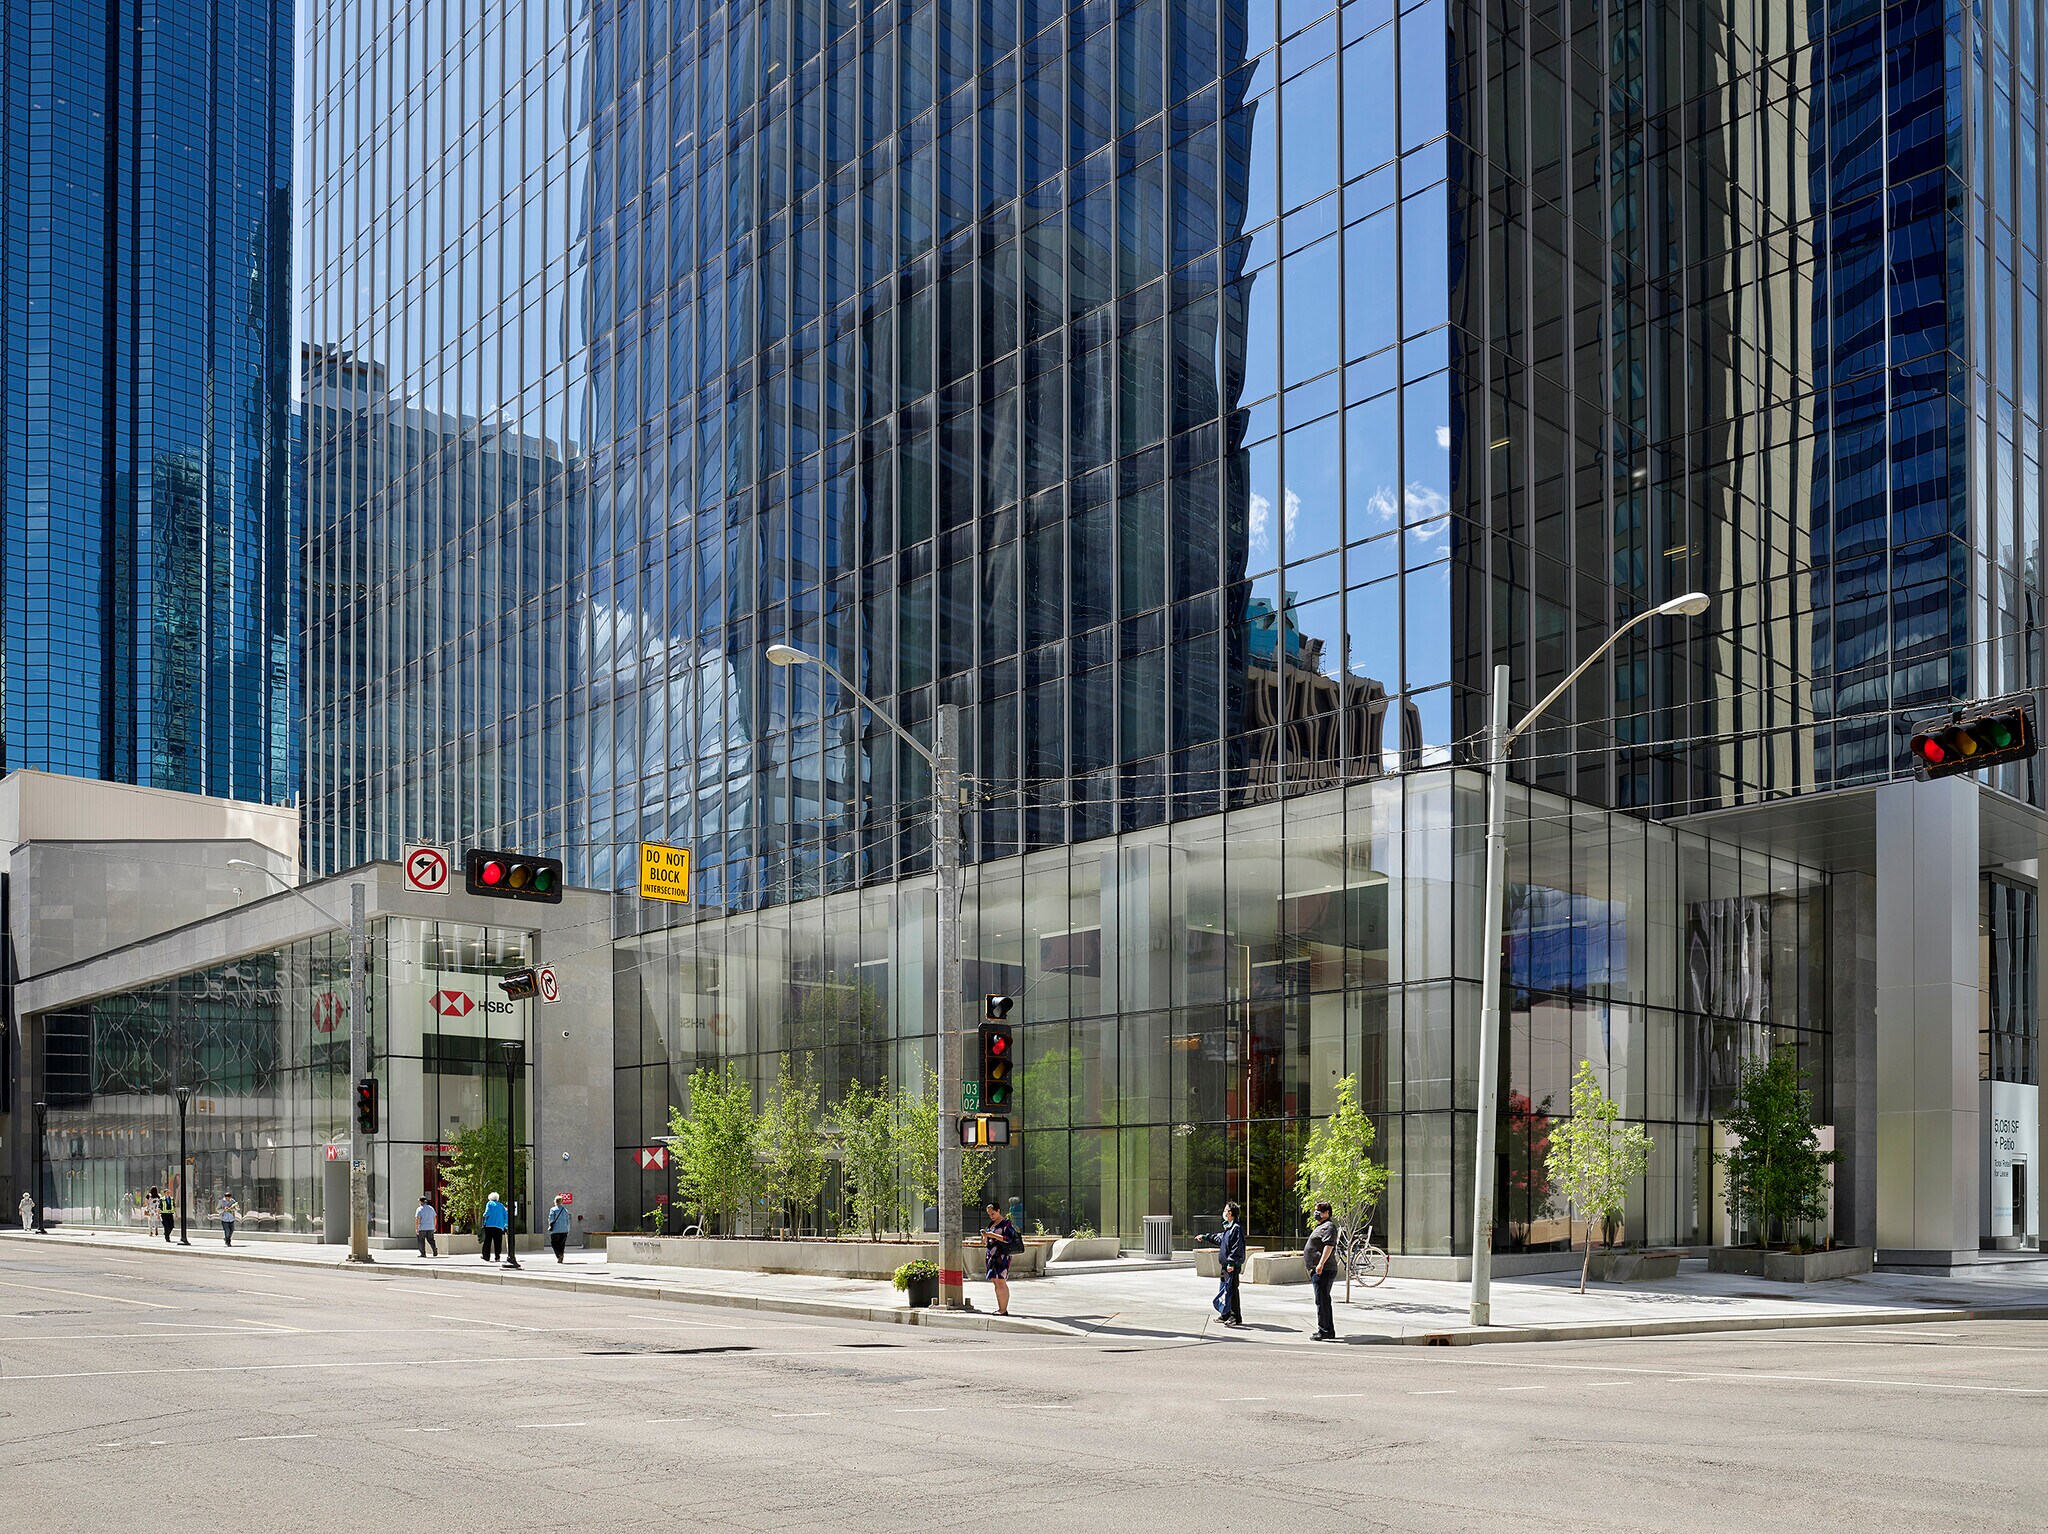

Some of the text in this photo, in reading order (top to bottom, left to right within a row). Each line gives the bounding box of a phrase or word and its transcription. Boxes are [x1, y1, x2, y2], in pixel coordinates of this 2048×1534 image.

[646, 850, 685, 867] DO NOT
[650, 867, 680, 883] BLOCK
[643, 884, 686, 896] INTERSECTION
[478, 1000, 514, 1014] HSBC
[962, 1083, 977, 1095] 103
[2011, 1120, 2019, 1133] SF
[2000, 1136, 2015, 1150] Patio
